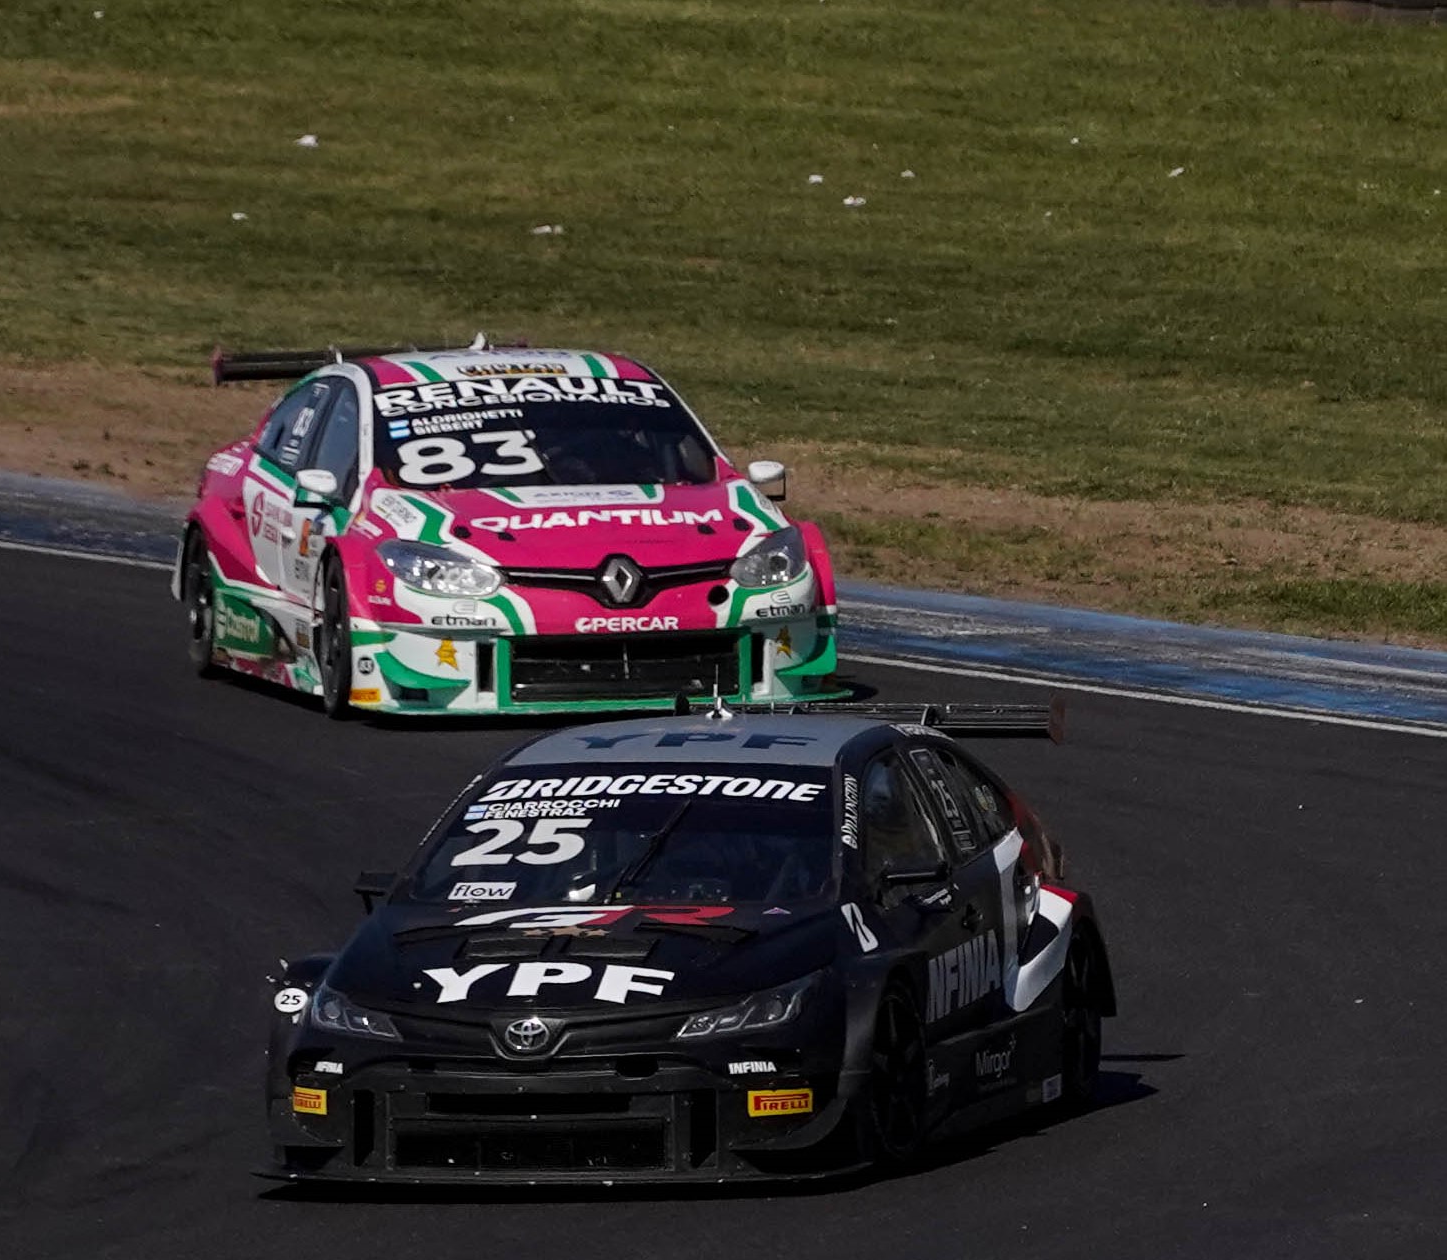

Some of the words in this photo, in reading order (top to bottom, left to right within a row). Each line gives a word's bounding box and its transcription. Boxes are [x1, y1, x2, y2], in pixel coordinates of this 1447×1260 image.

[374, 376, 663, 412] RENAULT
[381, 391, 671, 418] CONCESIONARIOS
[411, 408, 523, 428] ALDRIGHETTI
[397, 429, 544, 485] 83
[471, 509, 723, 533] QUANTIUM
[431, 613, 496, 627] etman
[575, 733, 818, 750] YPF
[478, 774, 826, 802] BRIDGESTONE
[483, 807, 587, 819] FENESTRAZ
[488, 799, 620, 812] CIARROCCHI
[450, 818, 593, 867] 25
[453, 884, 513, 898] flow
[422, 962, 675, 1004] YPF
[280, 994, 302, 1005] 25
[728, 1061, 777, 1075] INFINIA
[753, 1093, 809, 1111] PIRELLI
